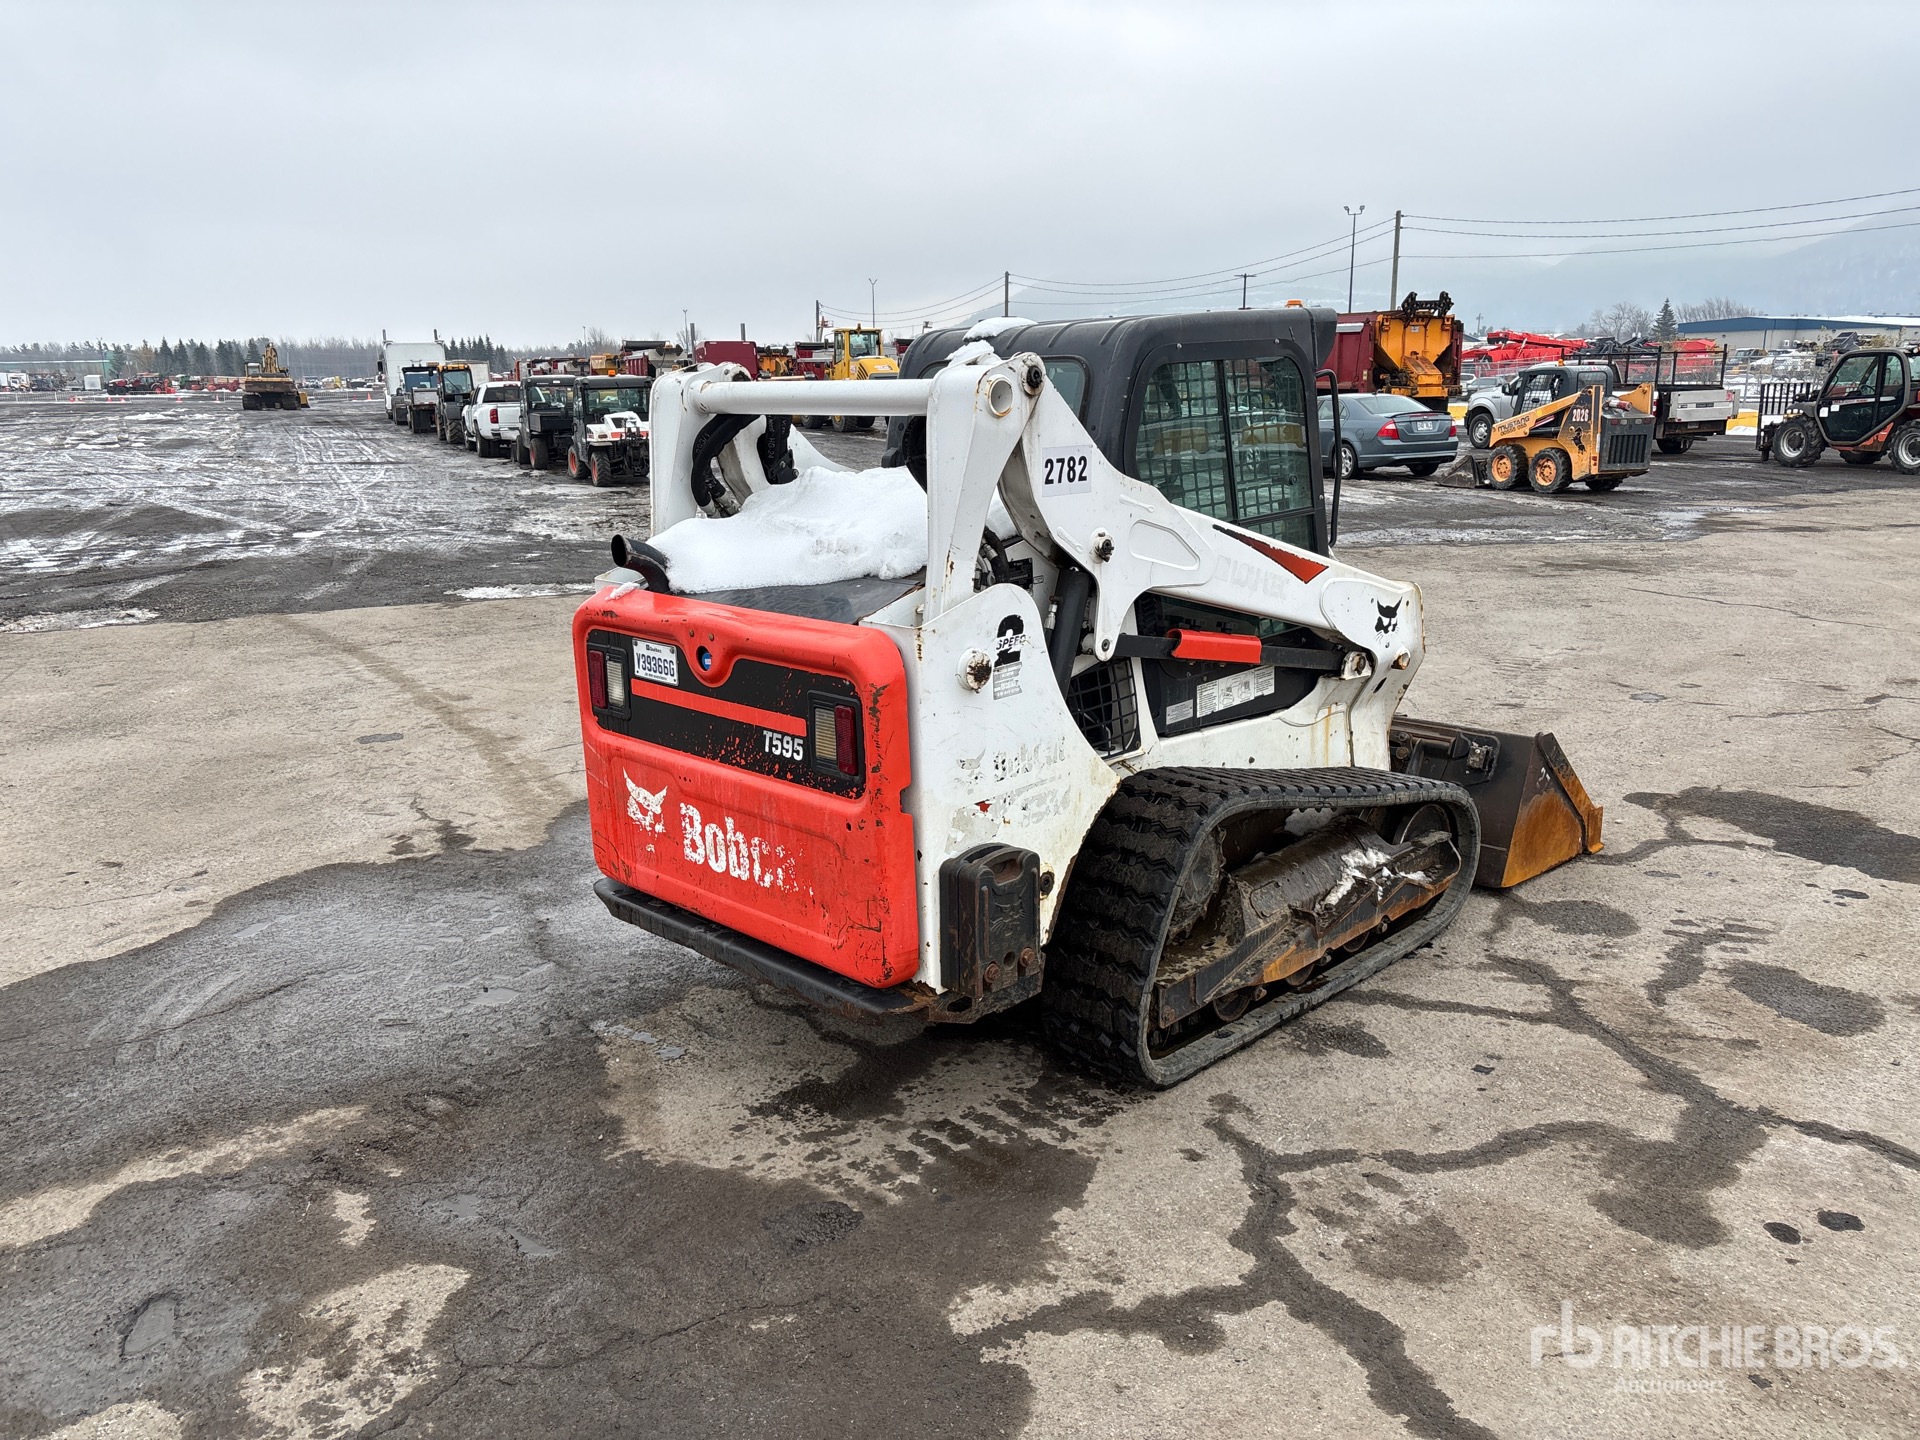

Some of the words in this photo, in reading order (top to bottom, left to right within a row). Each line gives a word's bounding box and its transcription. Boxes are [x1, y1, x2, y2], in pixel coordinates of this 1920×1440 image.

[1498, 415, 1530, 432] MUSTANG
[1044, 455, 1088, 485] 2782
[762, 730, 804, 761] T595
